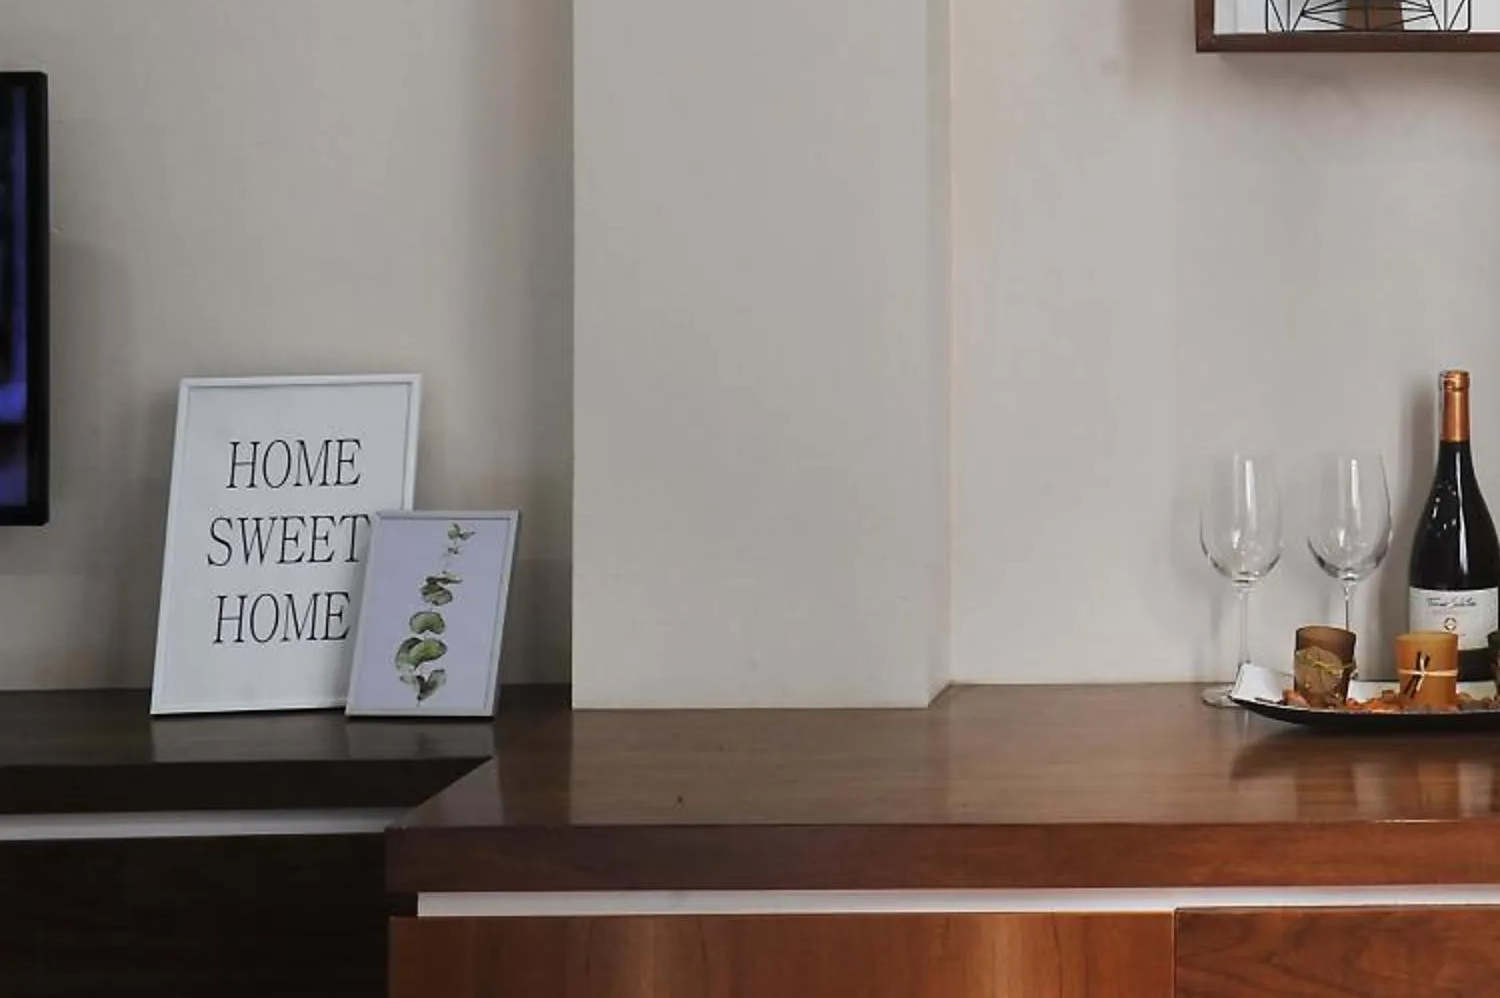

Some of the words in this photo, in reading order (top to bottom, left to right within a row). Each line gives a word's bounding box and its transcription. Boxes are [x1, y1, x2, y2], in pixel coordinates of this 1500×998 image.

[226, 438, 363, 490] HOME
[207, 513, 371, 566] SWEET
[212, 590, 351, 645] HOME
